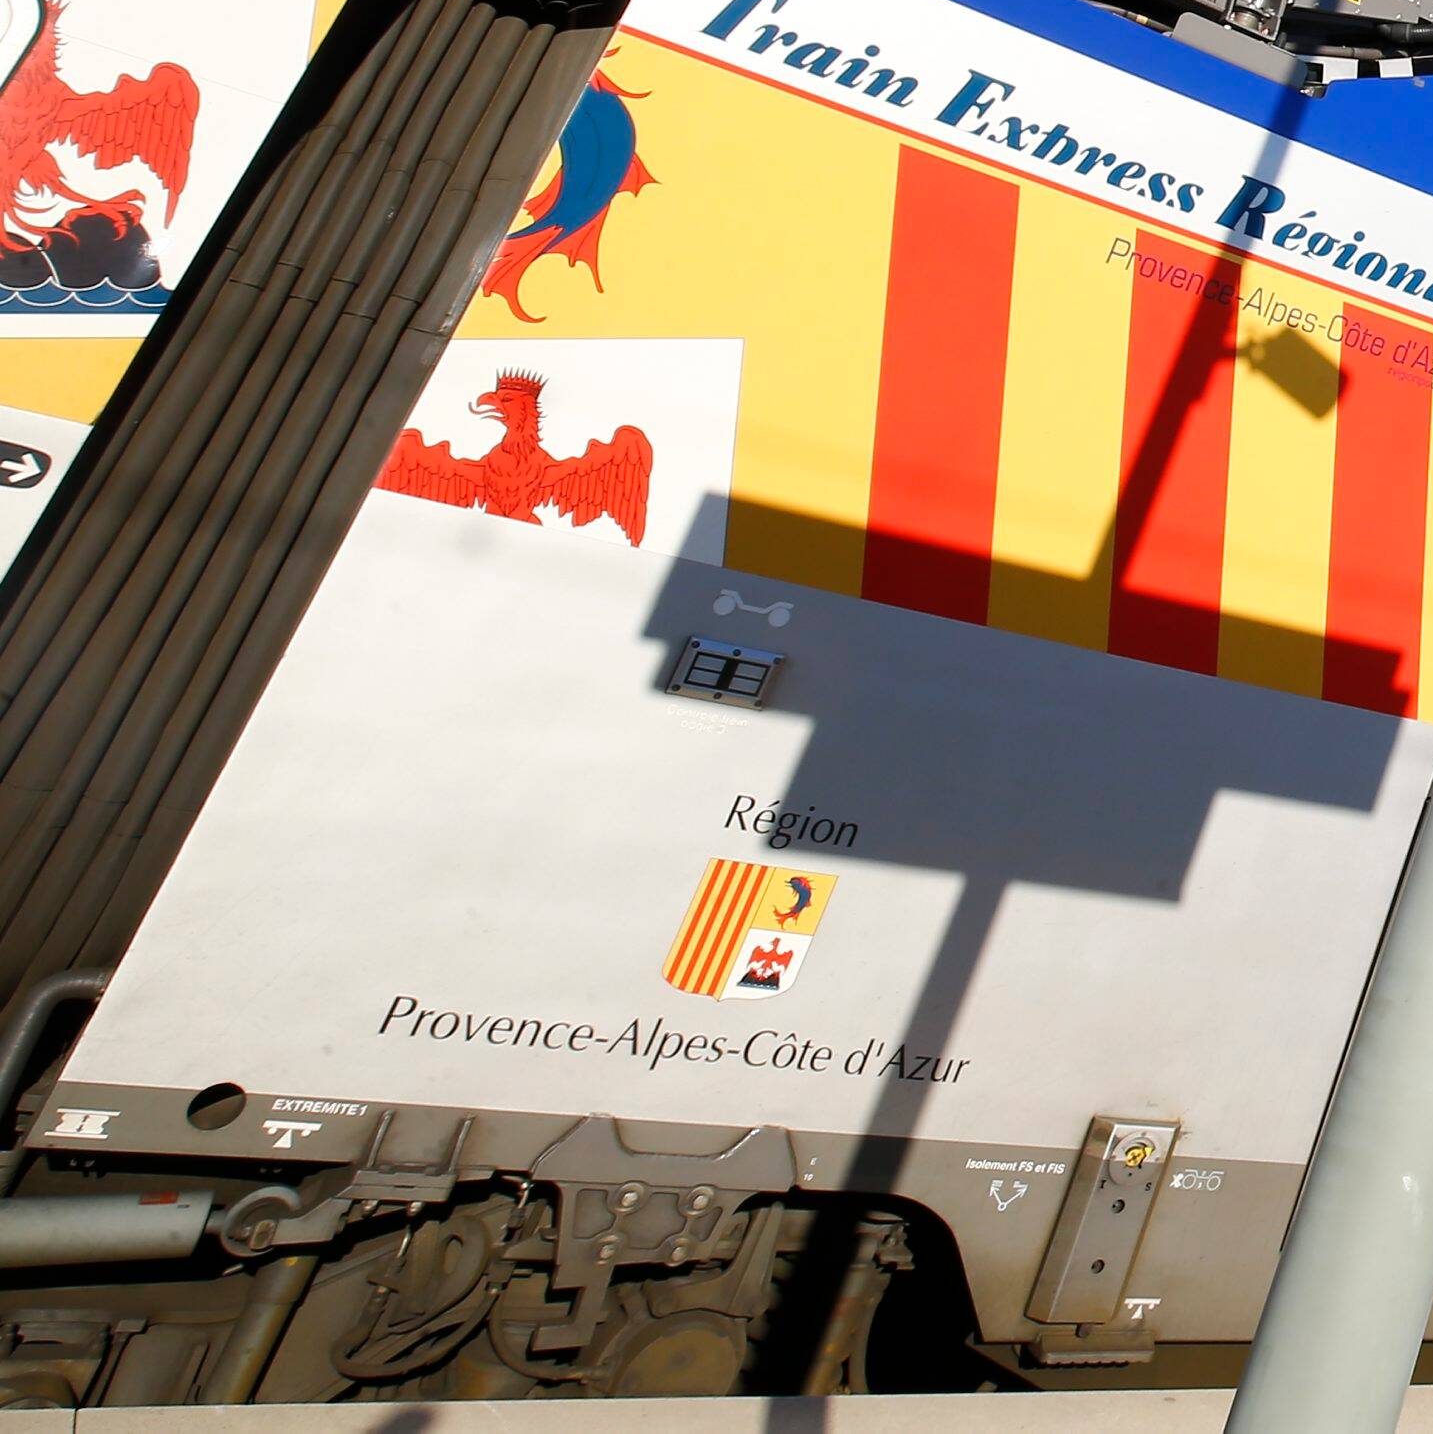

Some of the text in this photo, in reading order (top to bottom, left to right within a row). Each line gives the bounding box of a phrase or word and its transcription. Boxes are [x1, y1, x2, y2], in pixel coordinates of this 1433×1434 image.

[935, 68, 1204, 213] Express
[1105, 237, 1385, 357] Provence-Alpes-Côte
[724, 795, 859, 849] Région
[379, 995, 971, 1084] Provence-Alpes-Côte d'Azur
[965, 1158, 1066, 1175] Isolement FS et FIS
